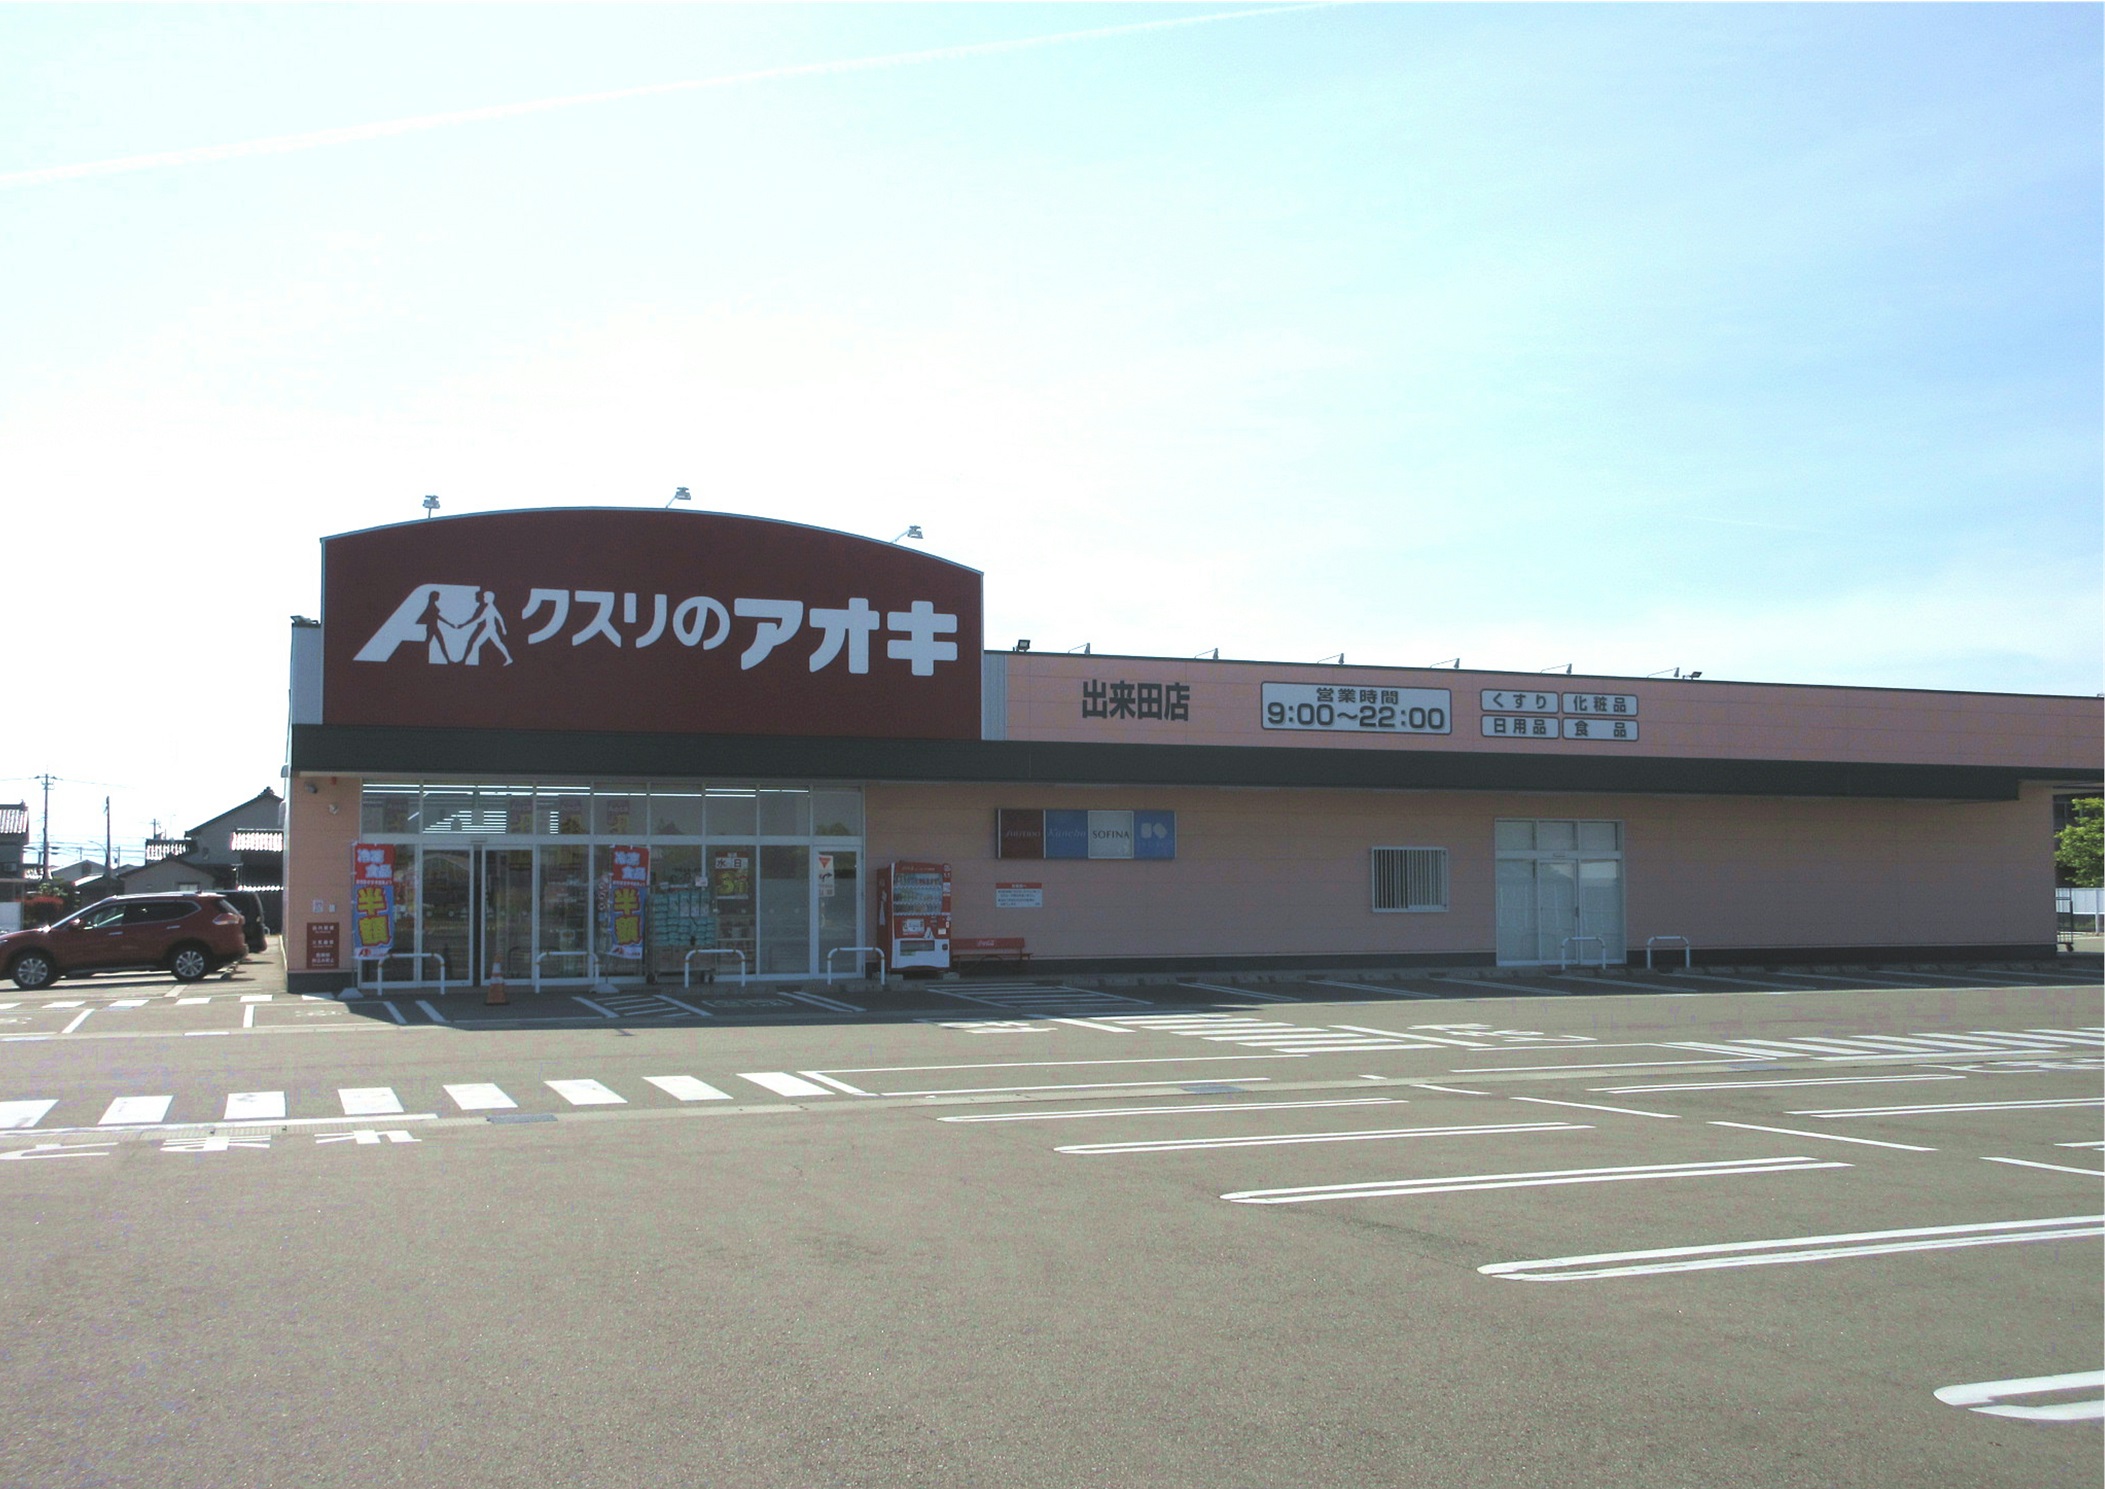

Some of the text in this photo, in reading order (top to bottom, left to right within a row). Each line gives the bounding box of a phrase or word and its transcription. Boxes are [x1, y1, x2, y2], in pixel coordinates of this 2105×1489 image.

[522, 588, 958, 676] クスリのアオキ
[1082, 679, 1190, 721] 出来田店
[1316, 687, 1398, 704] 営業時間
[1492, 693, 1547, 709] くすり
[1573, 695, 1627, 712] 化粧品
[1494, 718, 1547, 735] 日用品
[1093, 829, 1130, 840] SOFINA
